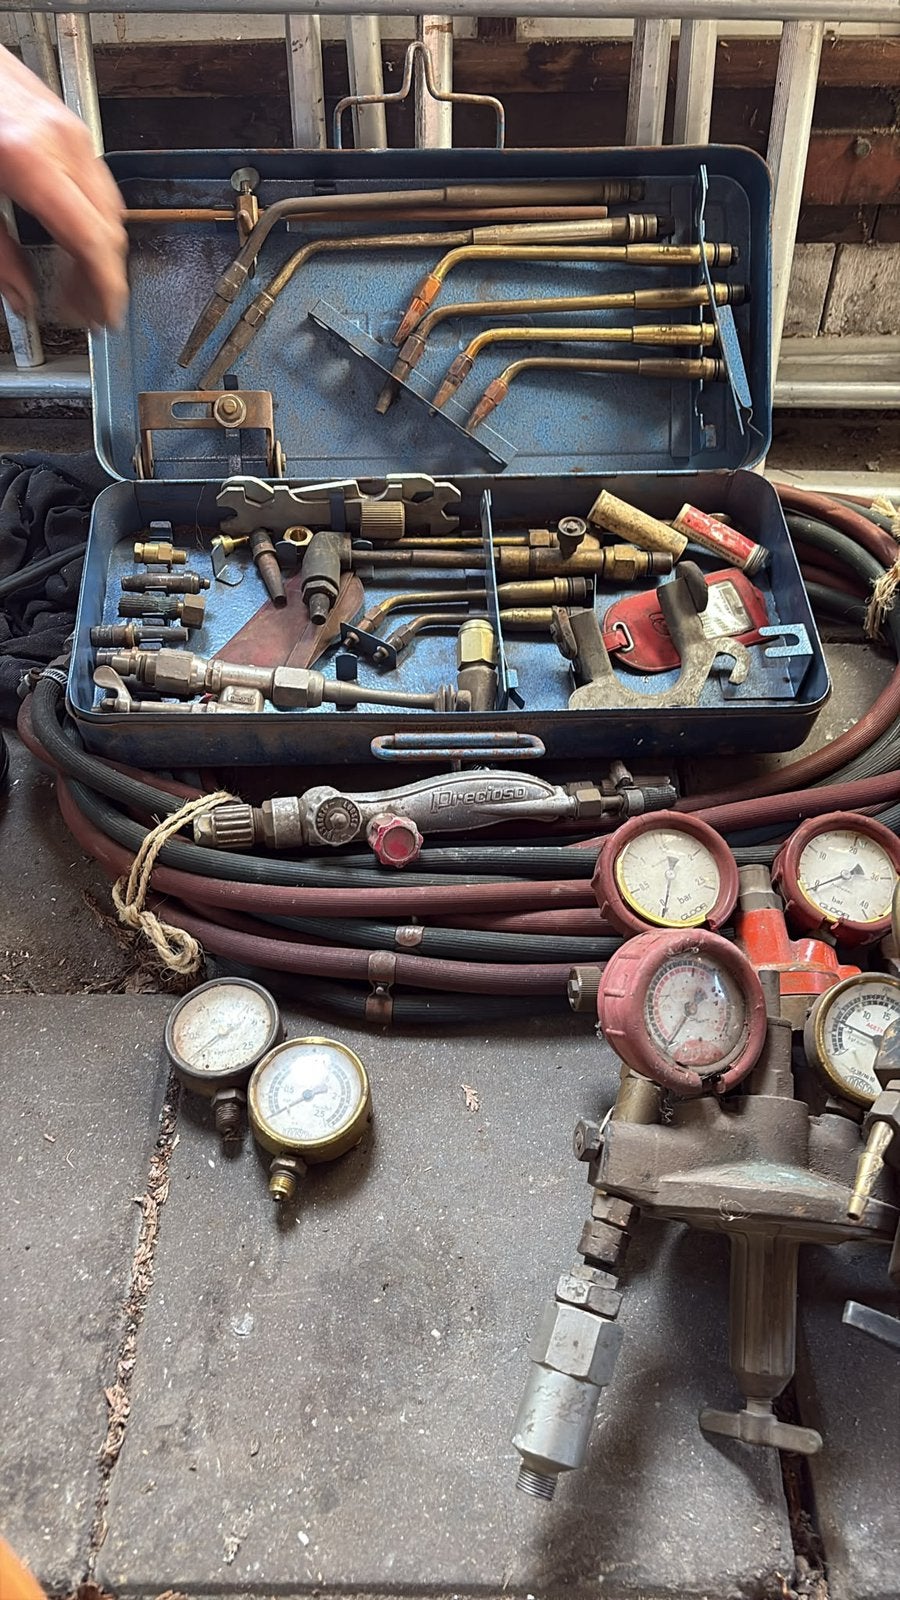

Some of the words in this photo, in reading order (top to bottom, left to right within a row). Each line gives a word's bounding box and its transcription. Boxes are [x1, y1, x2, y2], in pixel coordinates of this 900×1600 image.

[430, 786, 528, 814] Precioso
[819, 851, 827, 860] 10
[849, 846, 858, 855] 20
[677, 893, 692, 904] bar
[832, 896, 844, 906] bar
[859, 900, 870, 909] 40
[862, 1010, 871, 1021] 10
[882, 1011, 891, 1021] 15
